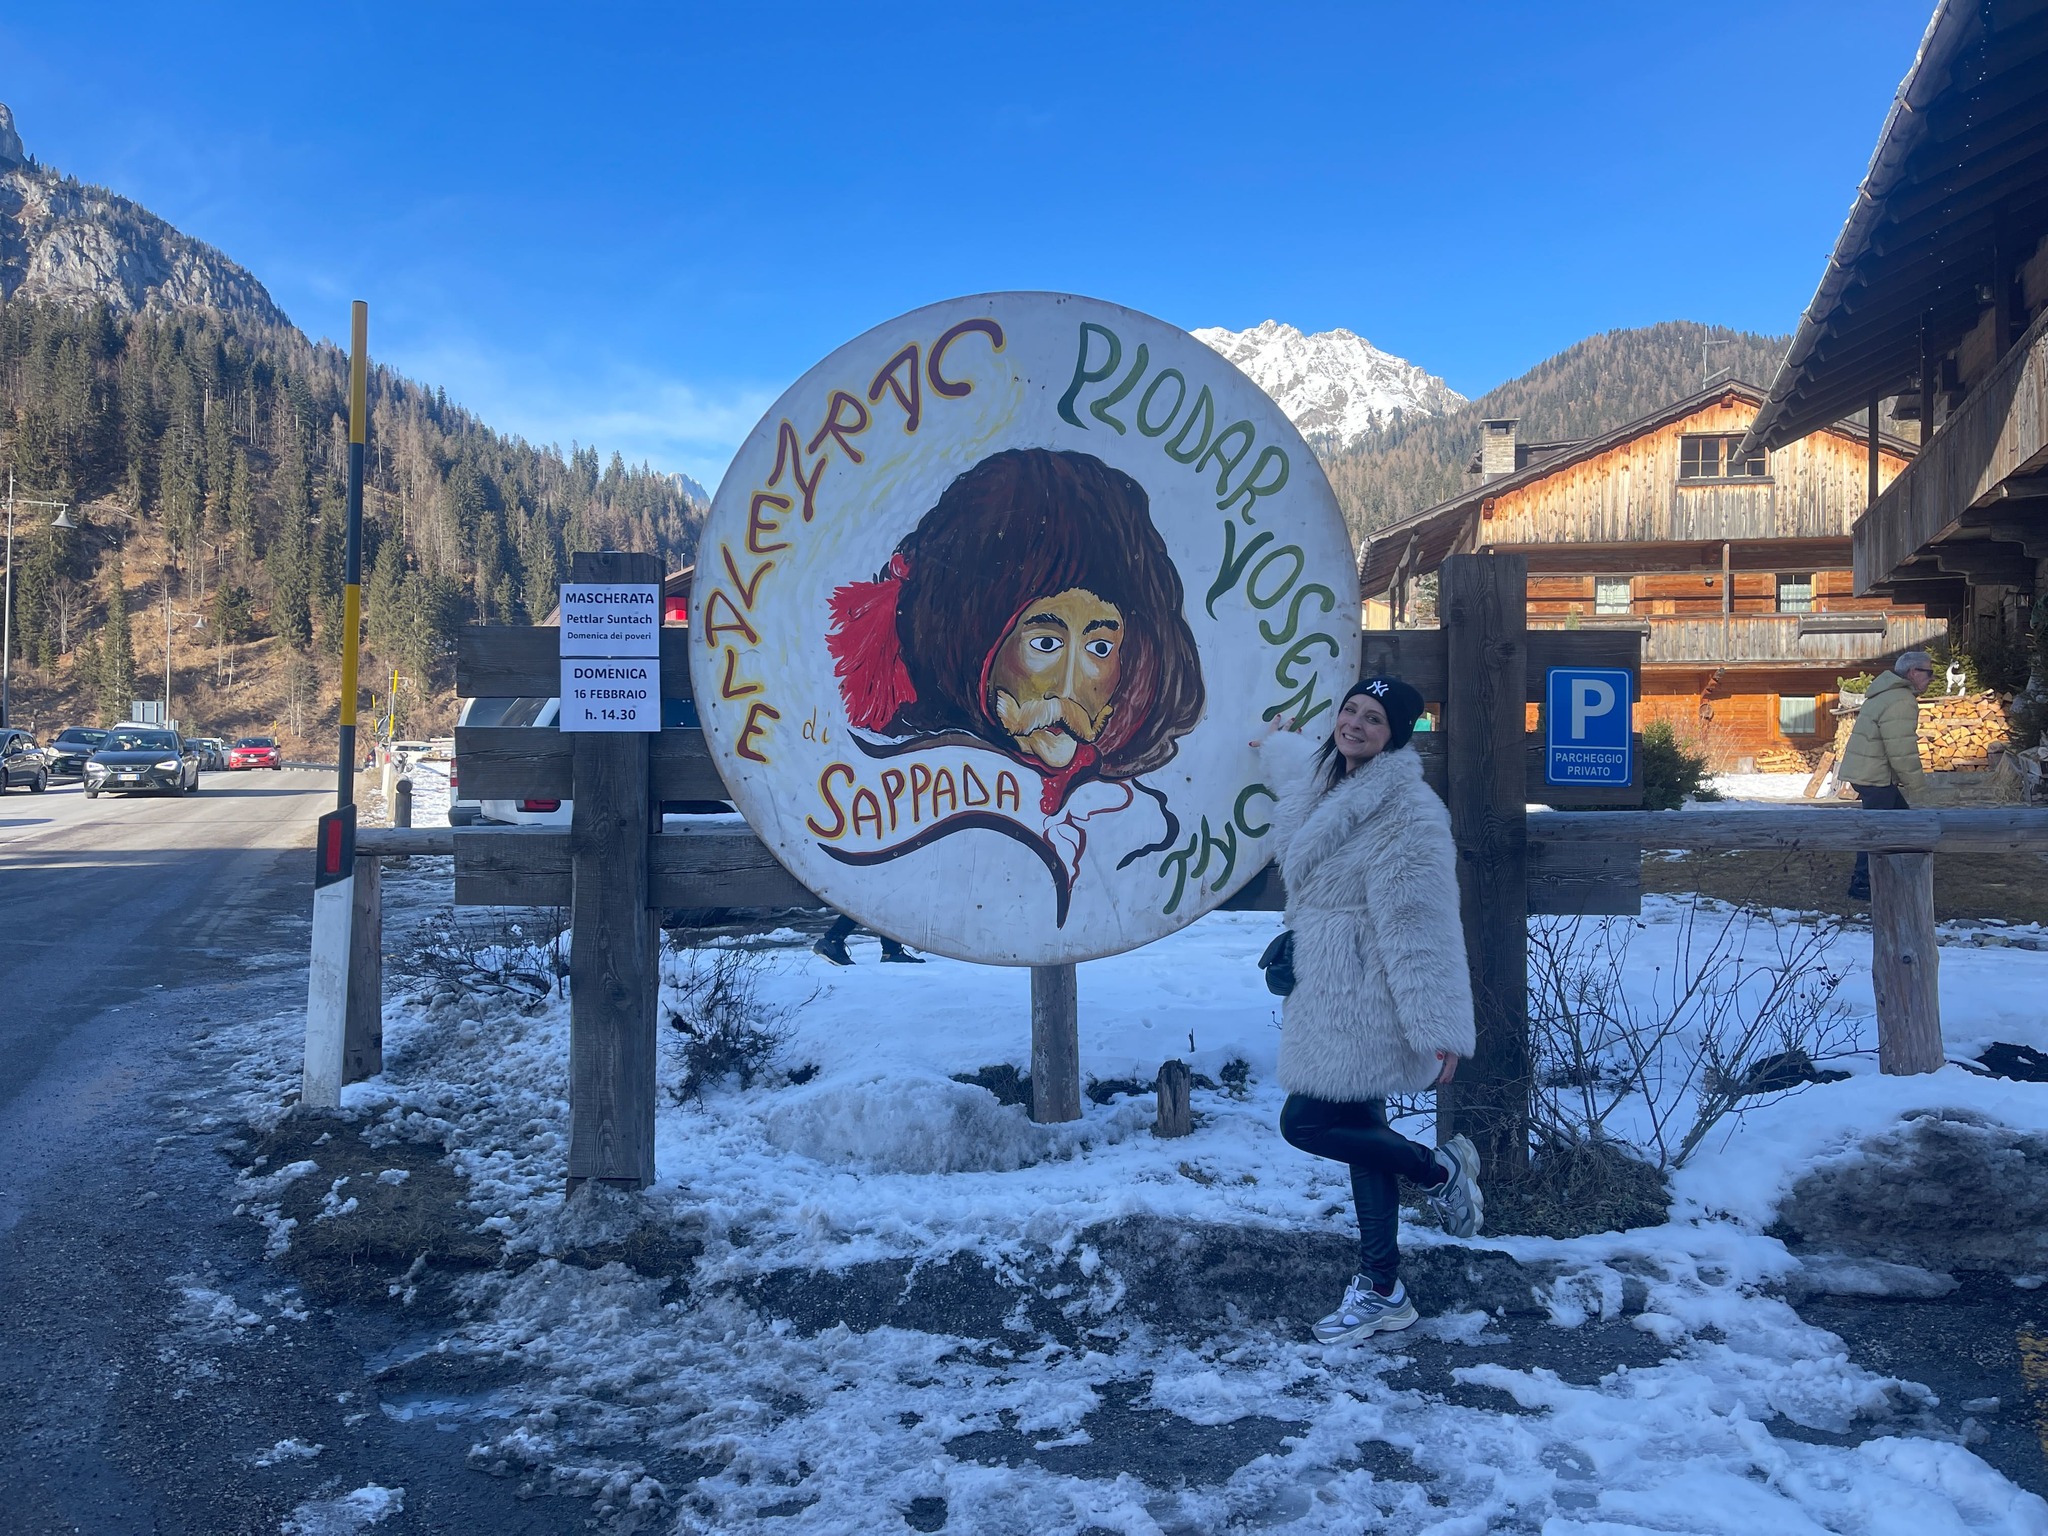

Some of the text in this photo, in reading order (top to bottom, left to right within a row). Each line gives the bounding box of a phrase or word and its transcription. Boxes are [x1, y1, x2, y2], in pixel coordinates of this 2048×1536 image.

[702, 317, 1021, 840] CARNEVALE di SAPPADA
[565, 593, 654, 603] MASCHERATA
[566, 614, 652, 624] Pettlar Suntach
[1057, 321, 1340, 915] PLODAR VOSENCHT
[567, 632, 652, 642] Domenica dei poveri
[574, 668, 648, 679] DOMENICA
[574, 689, 647, 700] 16 FEBBRAIO
[585, 709, 636, 720] h. 14.30
[1571, 679, 1616, 739] P
[1555, 752, 1623, 764] PARCHEGGIO
[1567, 766, 1611, 776] PRIVATO
